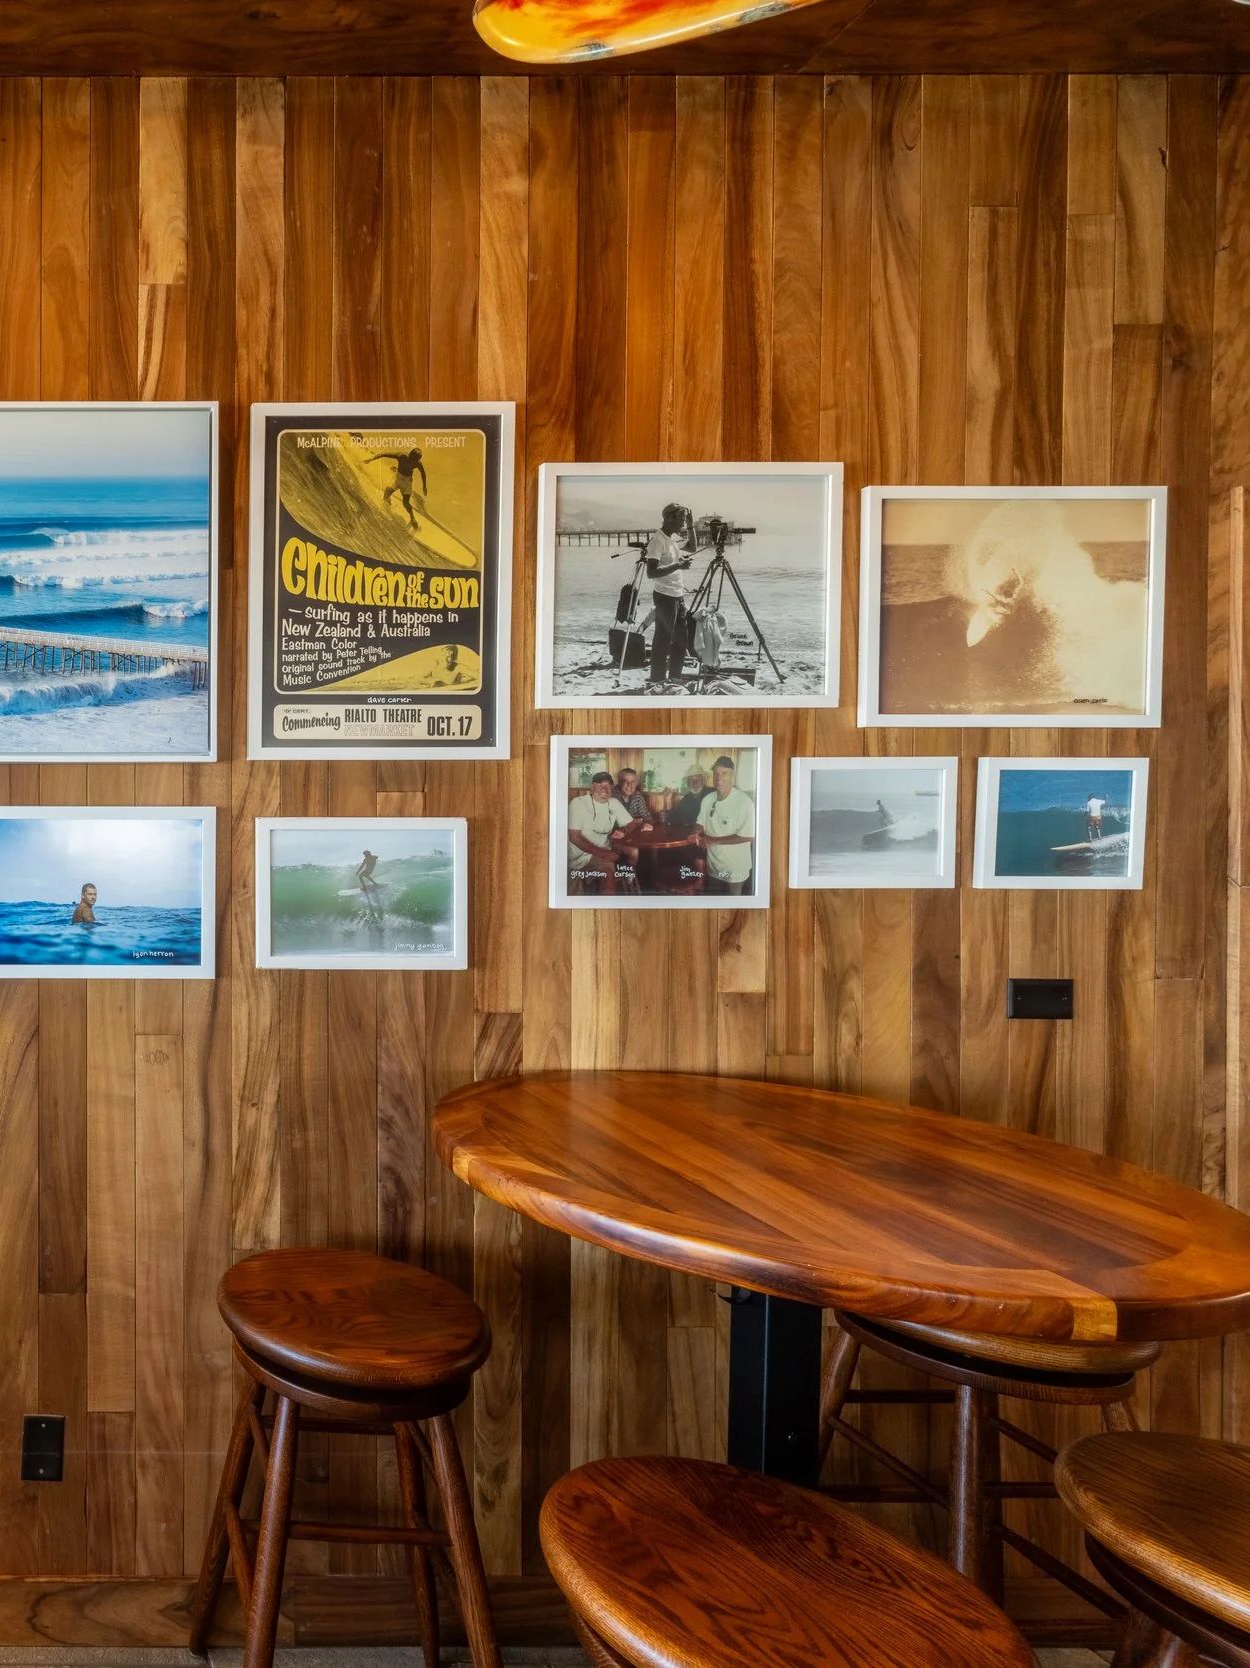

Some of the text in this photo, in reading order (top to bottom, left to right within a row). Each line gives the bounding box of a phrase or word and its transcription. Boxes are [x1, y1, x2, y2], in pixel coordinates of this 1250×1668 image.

[297, 436, 467, 448] McALPINE PRODUCTIONS PRESENT
[281, 537, 406, 607] Children
[408, 571, 424, 592] of
[405, 587, 429, 608] the
[305, 603, 350, 625] surfing
[357, 611, 373, 623] as
[378, 609, 387, 624] it
[392, 611, 443, 627] happens
[448, 611, 459, 623] in
[282, 618, 431, 638] New Zealand & Australia
[282, 637, 357, 650] Eastman Color
[282, 645, 383, 662] narrated by Peter Telling
[282, 651, 392, 675] original sound track by the
[283, 664, 361, 686] Music Convention
[367, 696, 386, 704] dave
[282, 712, 341, 732] Commencing
[344, 708, 422, 723] RIALTO THEATRE
[344, 724, 415, 737] NEWMARKET
[427, 716, 473, 737] OCT. 17
[570, 870, 585, 879] greg
